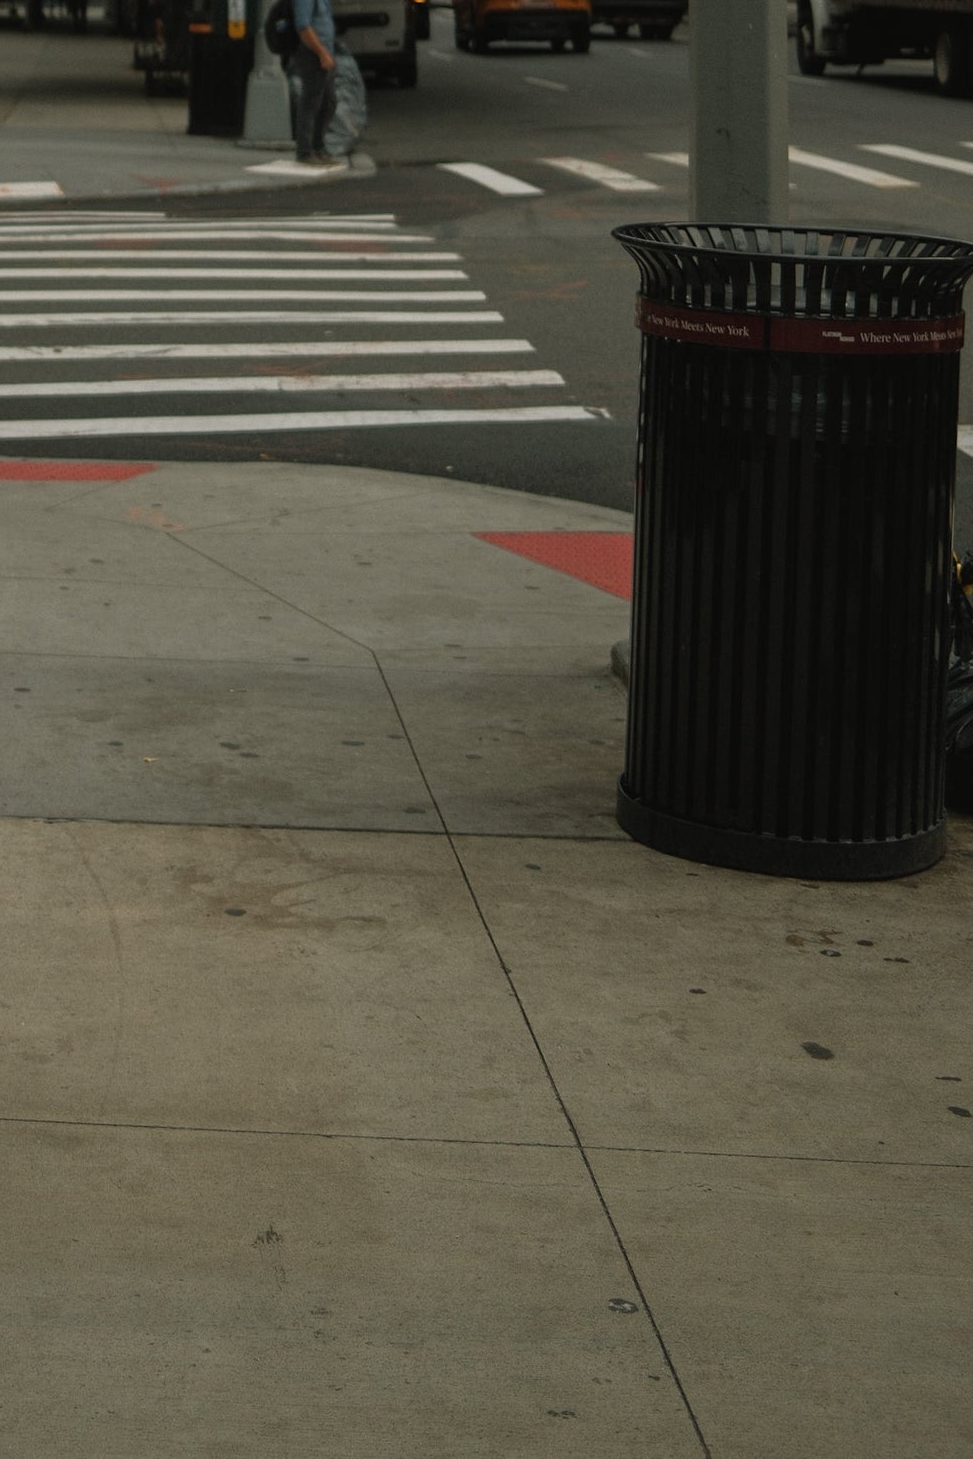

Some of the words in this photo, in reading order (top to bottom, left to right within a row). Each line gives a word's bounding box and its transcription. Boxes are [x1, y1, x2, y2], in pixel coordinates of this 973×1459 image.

[664, 317, 680, 329] York
[681, 320, 704, 332] Meets
[705, 323, 725, 334] New
[726, 325, 750, 337] York
[860, 332, 892, 343] Where
[893, 333, 911, 343] New
[912, 332, 929, 342] York
